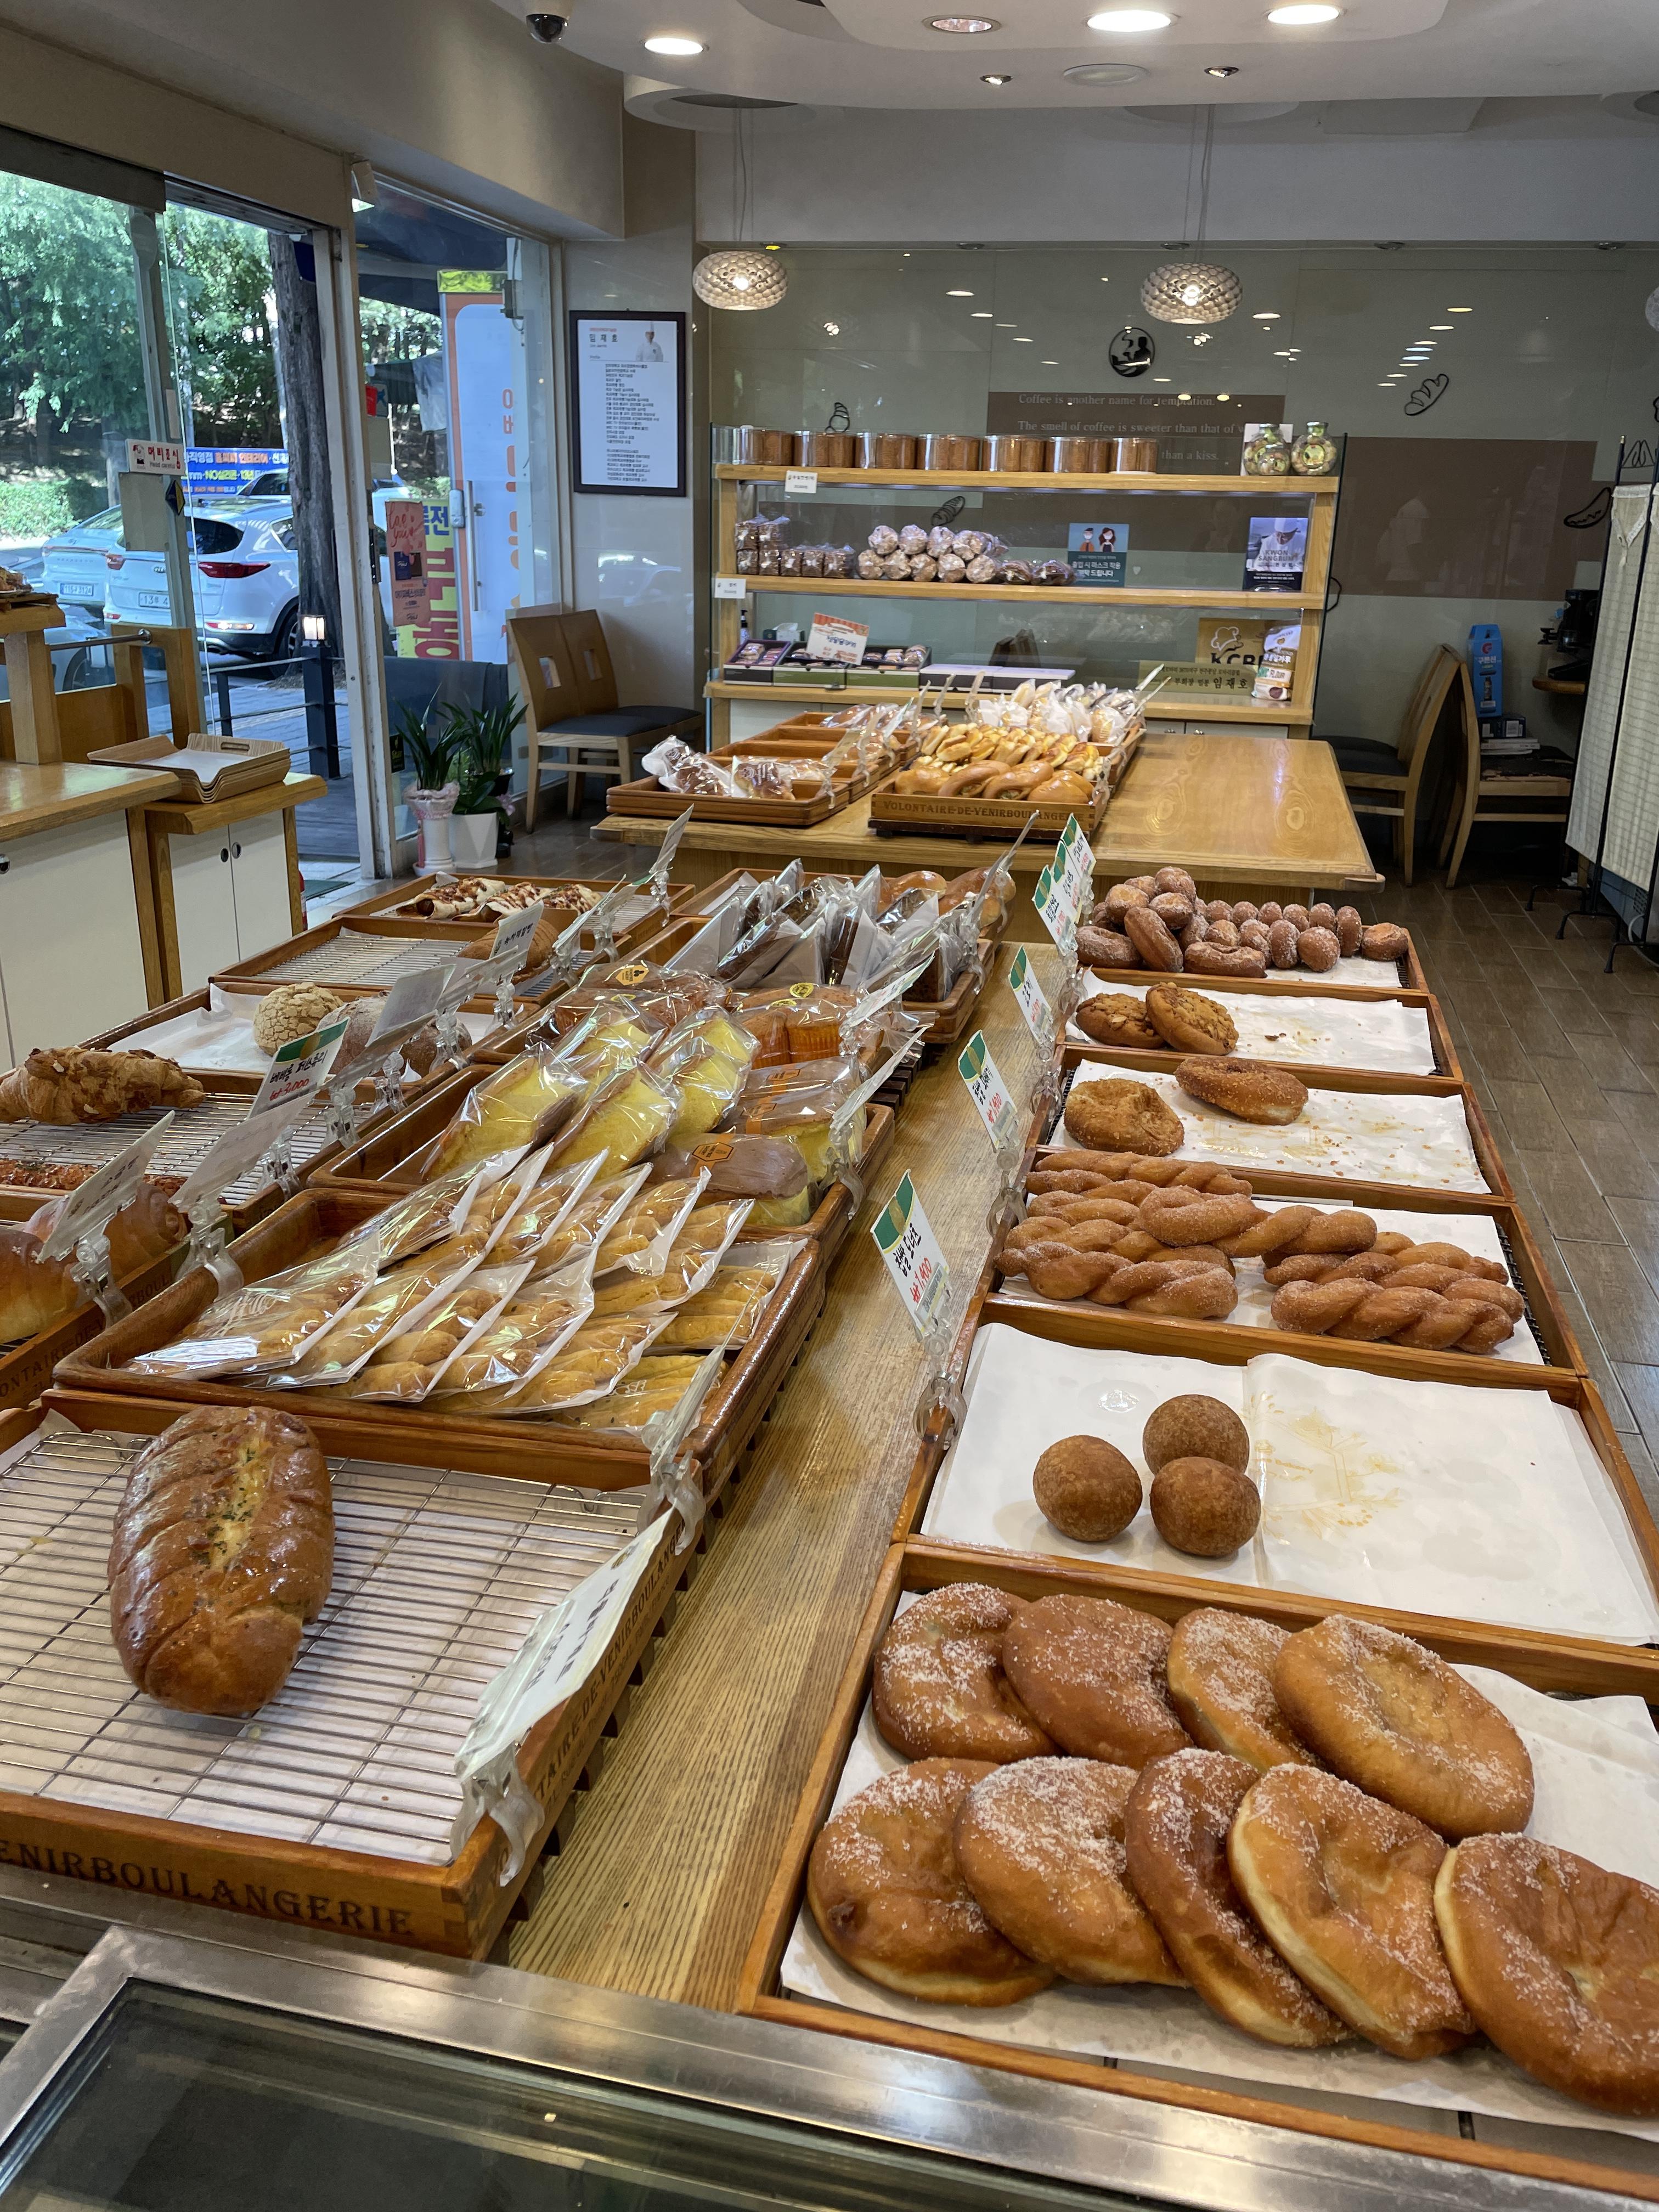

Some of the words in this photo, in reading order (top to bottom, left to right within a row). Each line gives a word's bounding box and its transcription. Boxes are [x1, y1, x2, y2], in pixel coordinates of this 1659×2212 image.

[1019, 394, 1053, 404] Coffee
[1055, 395, 1064, 404] is
[1066, 396, 1106, 405] another
[1108, 397, 1136, 405] name
[1139, 395, 1152, 405] for
[1018, 421, 1037, 431] The
[1041, 421, 1067, 431] smell
[1070, 421, 1081, 431] of
[1083, 422, 1116, 432] coffee
[1118, 422, 1127, 432] is
[1130, 424, 1173, 432] sweeter
[1175, 423, 1198, 433] than
[1200, 424, 1221, 433] that
[1224, 423, 1235, 433] of
[1161, 450, 1184, 460] than
[1195, 450, 1219, 460] kiss.
[893, 1244, 912, 1278] 찹쌀
[903, 1222, 922, 1259] 도너츠
